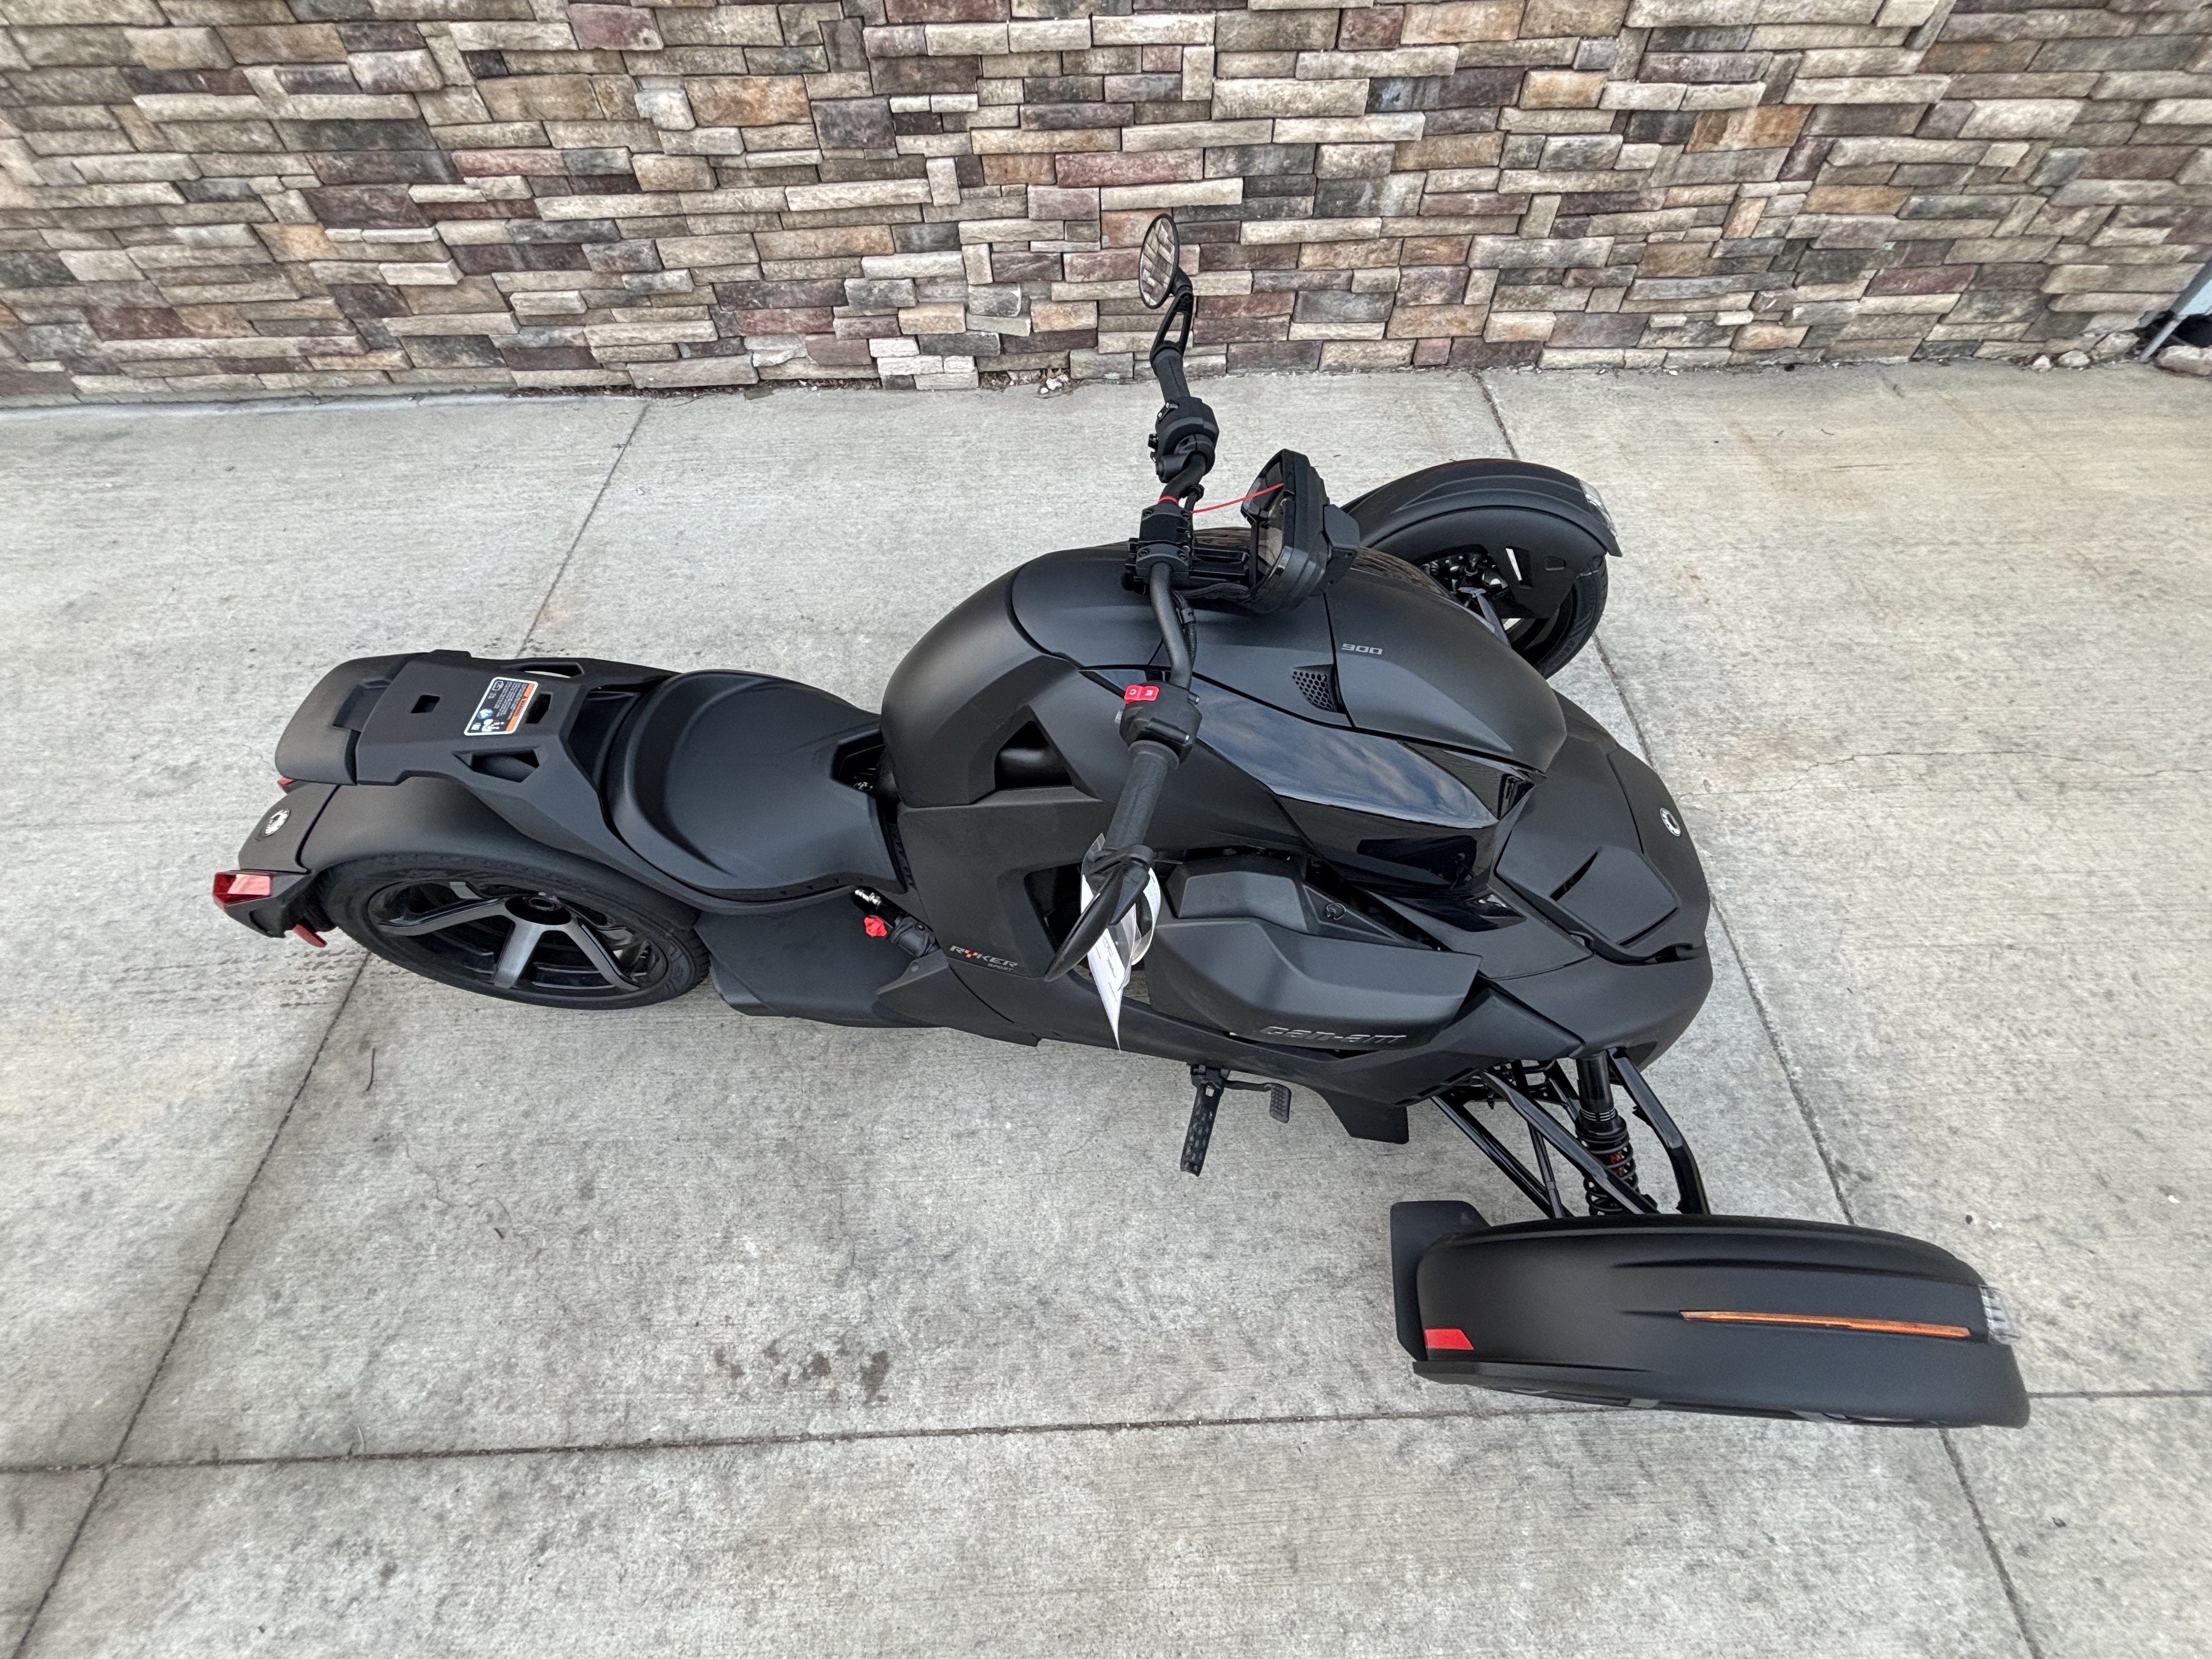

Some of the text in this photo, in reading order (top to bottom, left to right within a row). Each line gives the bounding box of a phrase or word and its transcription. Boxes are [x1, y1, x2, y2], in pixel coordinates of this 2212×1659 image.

[1342, 644, 1383, 654] 900
[950, 945, 1018, 968] RYKER
[988, 963, 1013, 972] SPORT
